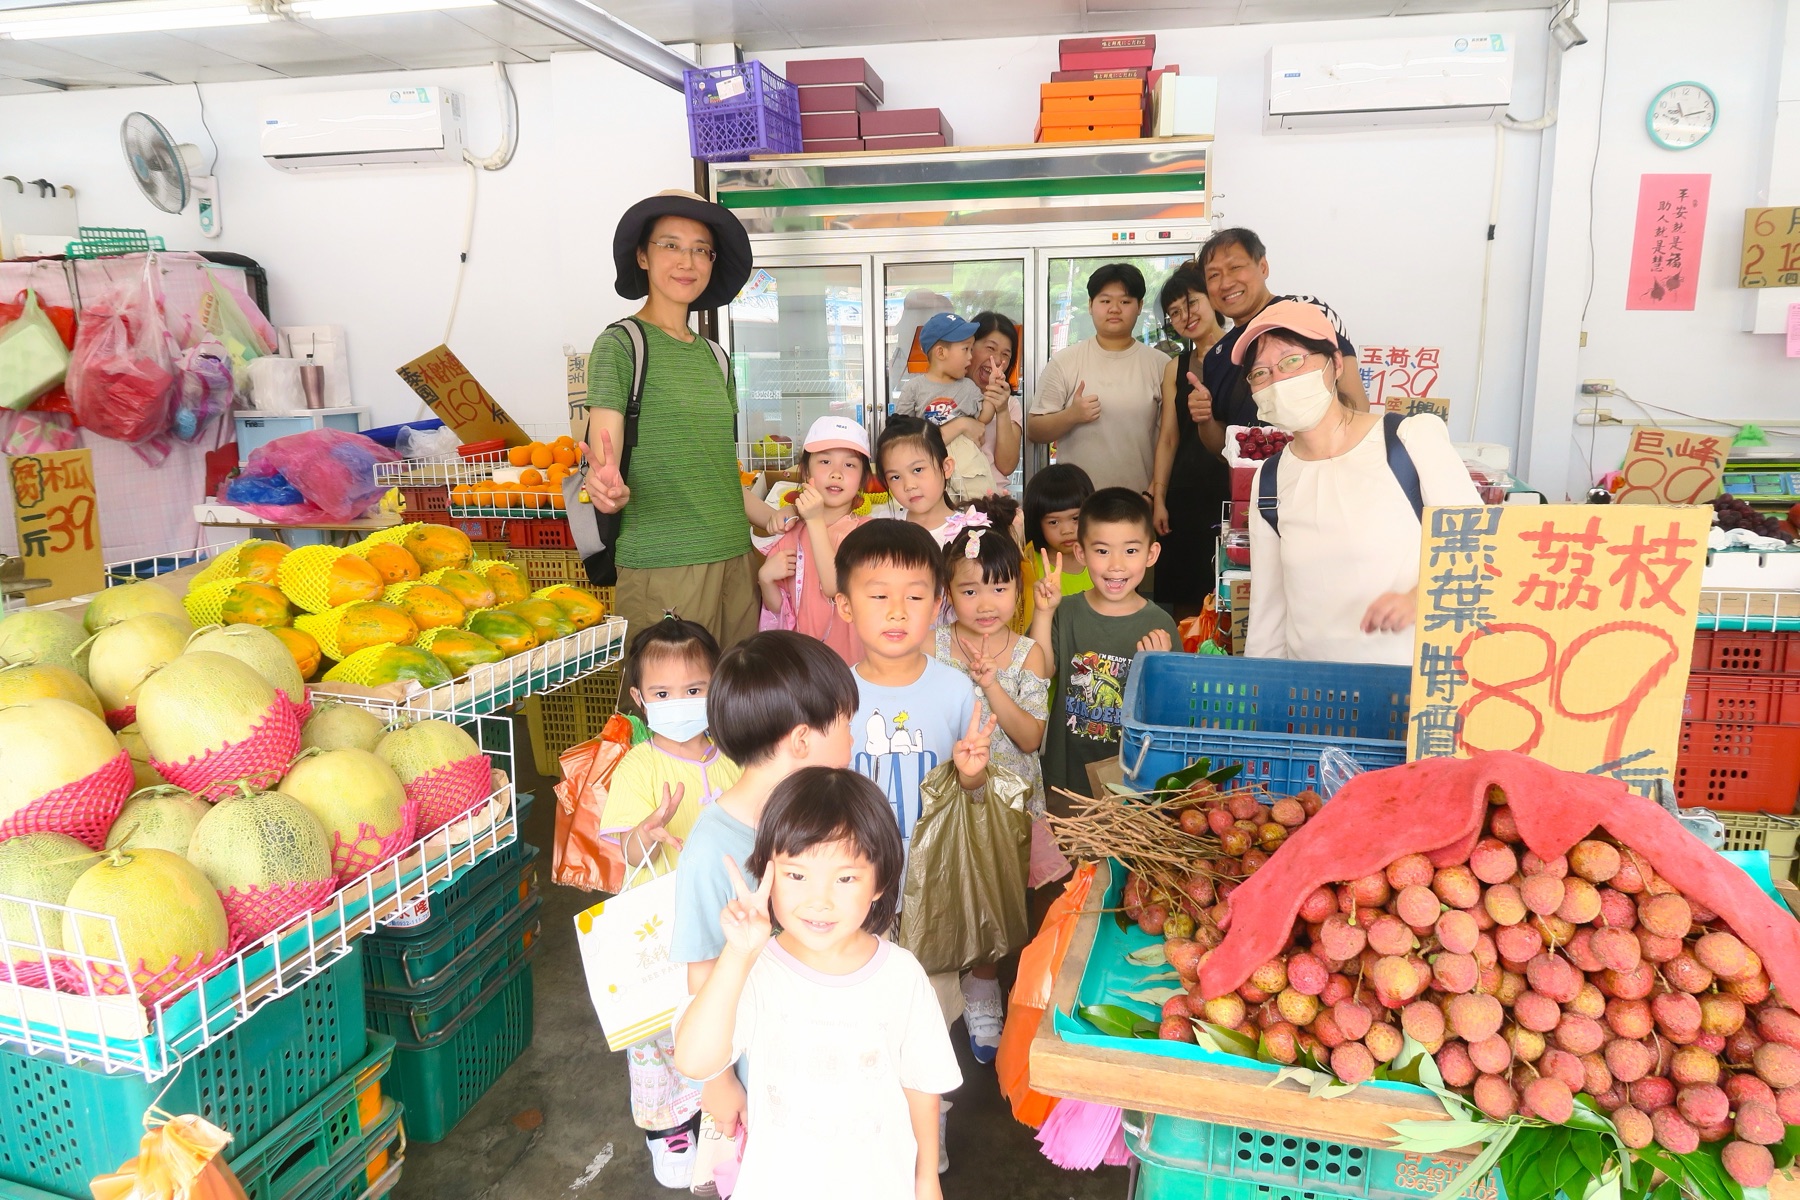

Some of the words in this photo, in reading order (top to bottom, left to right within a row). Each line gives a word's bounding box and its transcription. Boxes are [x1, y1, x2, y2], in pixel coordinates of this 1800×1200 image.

[1665, 188, 1689, 269] 平安就是福
[1754, 208, 1775, 237] 6
[1744, 243, 1765, 276] 2
[398, 366, 440, 406] 泰國
[435, 379, 494, 430] 169
[1370, 368, 1438, 406] 139
[1633, 430, 1722, 467] 巨峰
[41, 457, 96, 495] 木瓜
[1616, 457, 1716, 504] 89
[46, 495, 95, 553] 39
[1512, 516, 1698, 617] 荔枝
[1107, 654, 1127, 663] READY
[1453, 620, 1679, 768] 89
